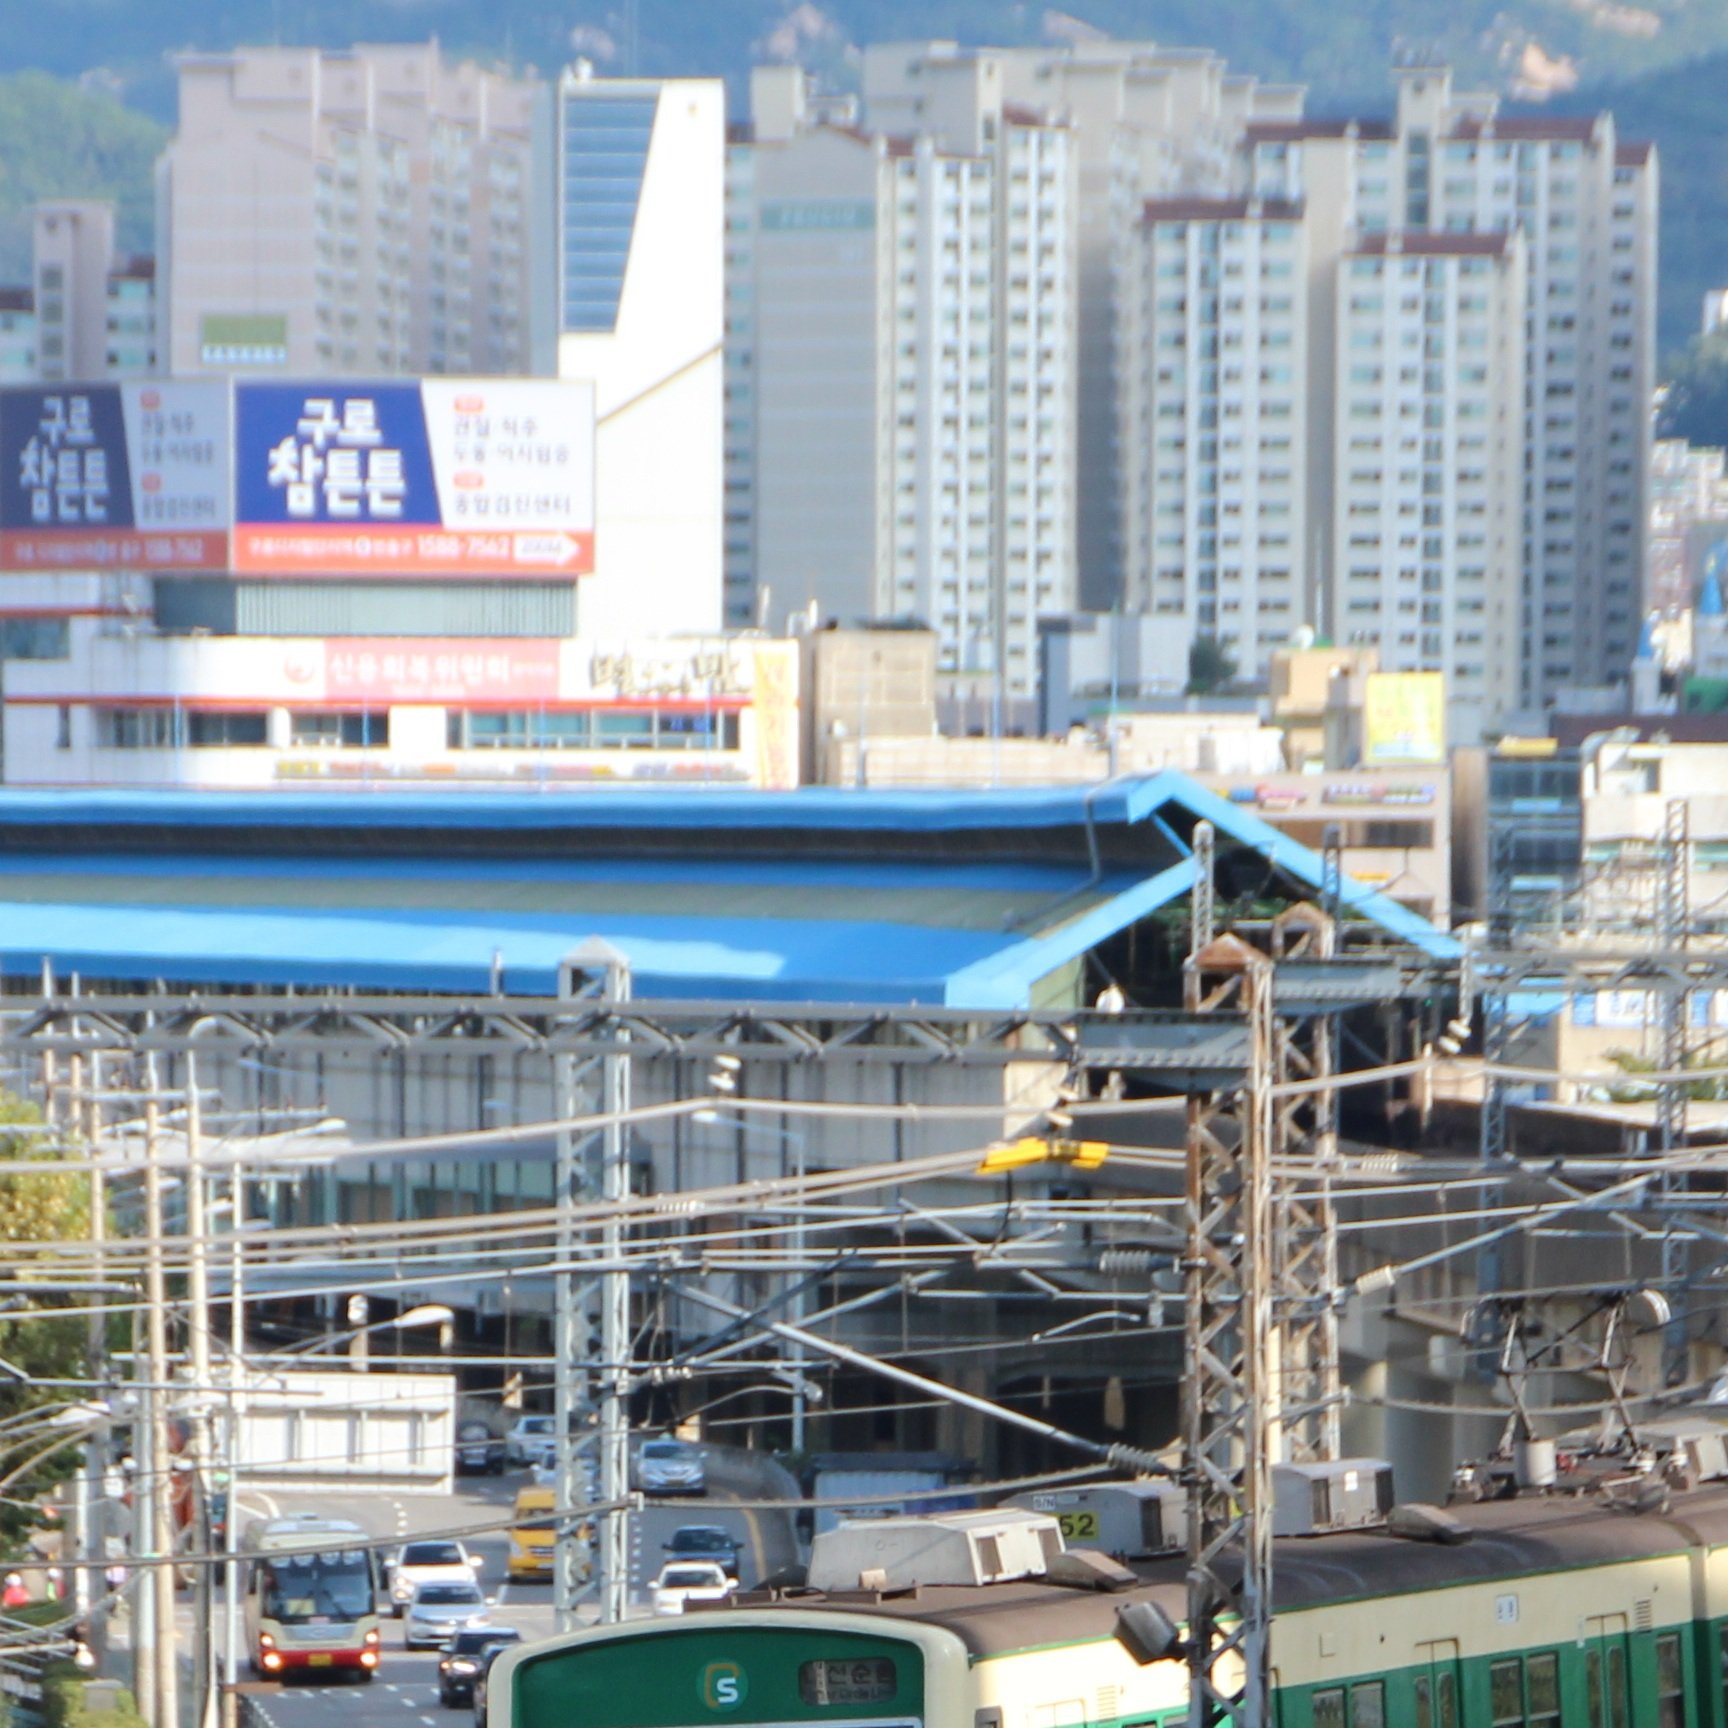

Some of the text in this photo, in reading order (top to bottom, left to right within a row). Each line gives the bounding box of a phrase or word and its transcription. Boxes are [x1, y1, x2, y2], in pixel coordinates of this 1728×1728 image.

[39, 396, 95, 447] 구로
[297, 397, 383, 450] 구로
[19, 435, 110, 522] 참튼튼
[267, 436, 406, 518] 참튼튼
